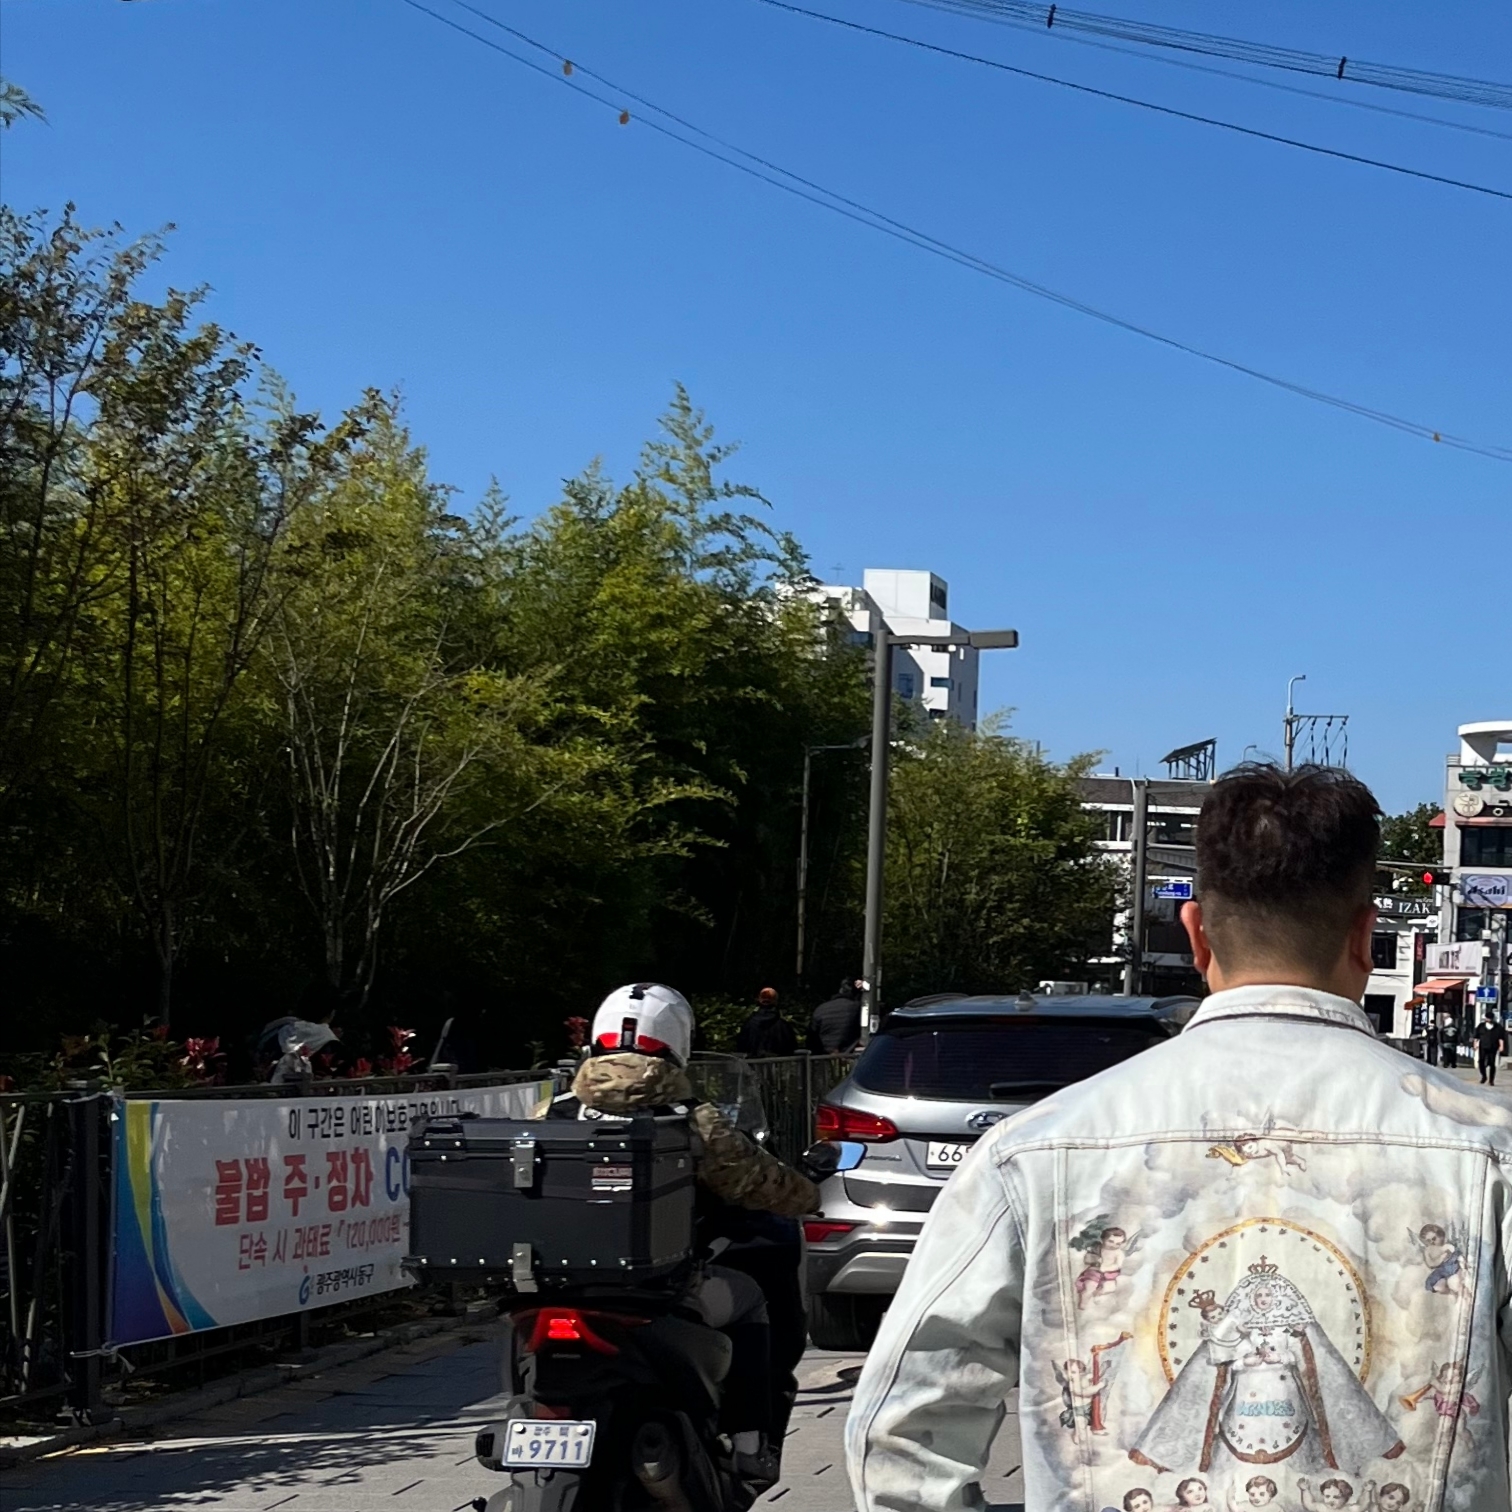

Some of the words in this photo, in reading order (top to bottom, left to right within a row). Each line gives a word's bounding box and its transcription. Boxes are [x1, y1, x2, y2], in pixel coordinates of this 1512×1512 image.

[1467, 885, 1506, 896] Asahi
[289, 1109, 300, 1140] 이
[307, 1106, 345, 1139] 구간은
[938, 1145, 973, 1162] 66
[215, 1157, 270, 1226] 불법
[239, 1233, 267, 1270] 단속
[272, 1230, 286, 1263] 시
[293, 1223, 332, 1261] 과태료
[529, 1440, 583, 1460] 9711
